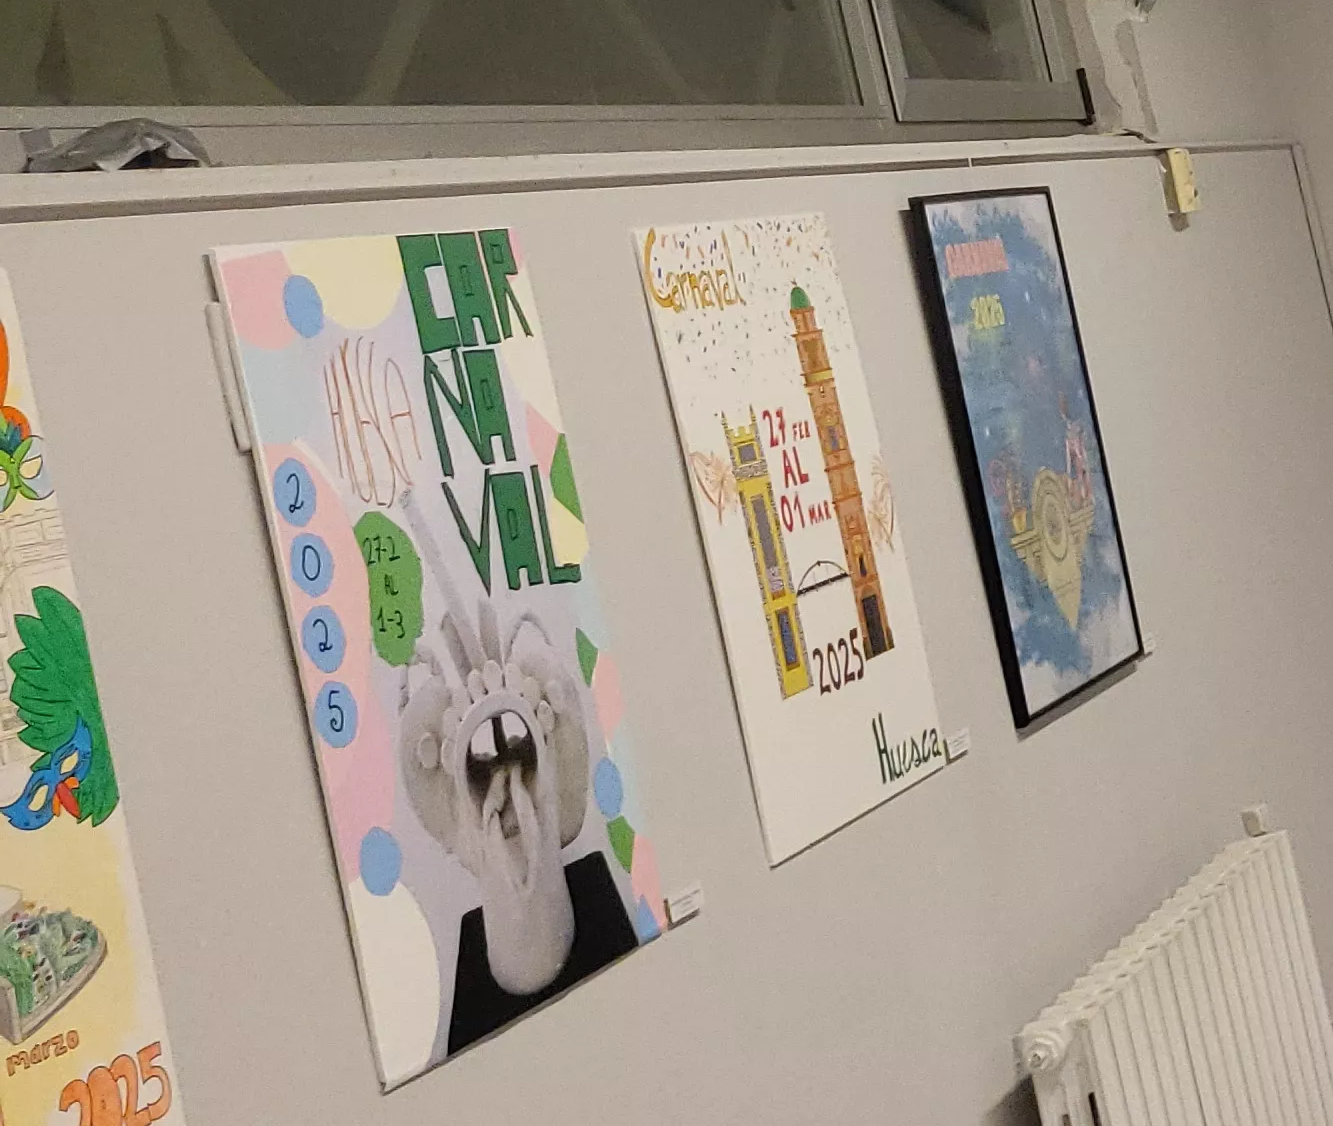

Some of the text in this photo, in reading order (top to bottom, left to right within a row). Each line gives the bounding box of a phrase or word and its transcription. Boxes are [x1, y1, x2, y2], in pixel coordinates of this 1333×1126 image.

[396, 230, 534, 354] CAR
[644, 226, 747, 314] Carnaval
[423, 349, 516, 480] NA
[762, 407, 786, 448] 27
[782, 446, 809, 488] AL
[441, 465, 582, 597] VAL
[780, 491, 832, 533] 01 MAR
[812, 627, 865, 696] 2025
[872, 712, 943, 785] Huesca
[6, 1029, 80, 1077] marzo
